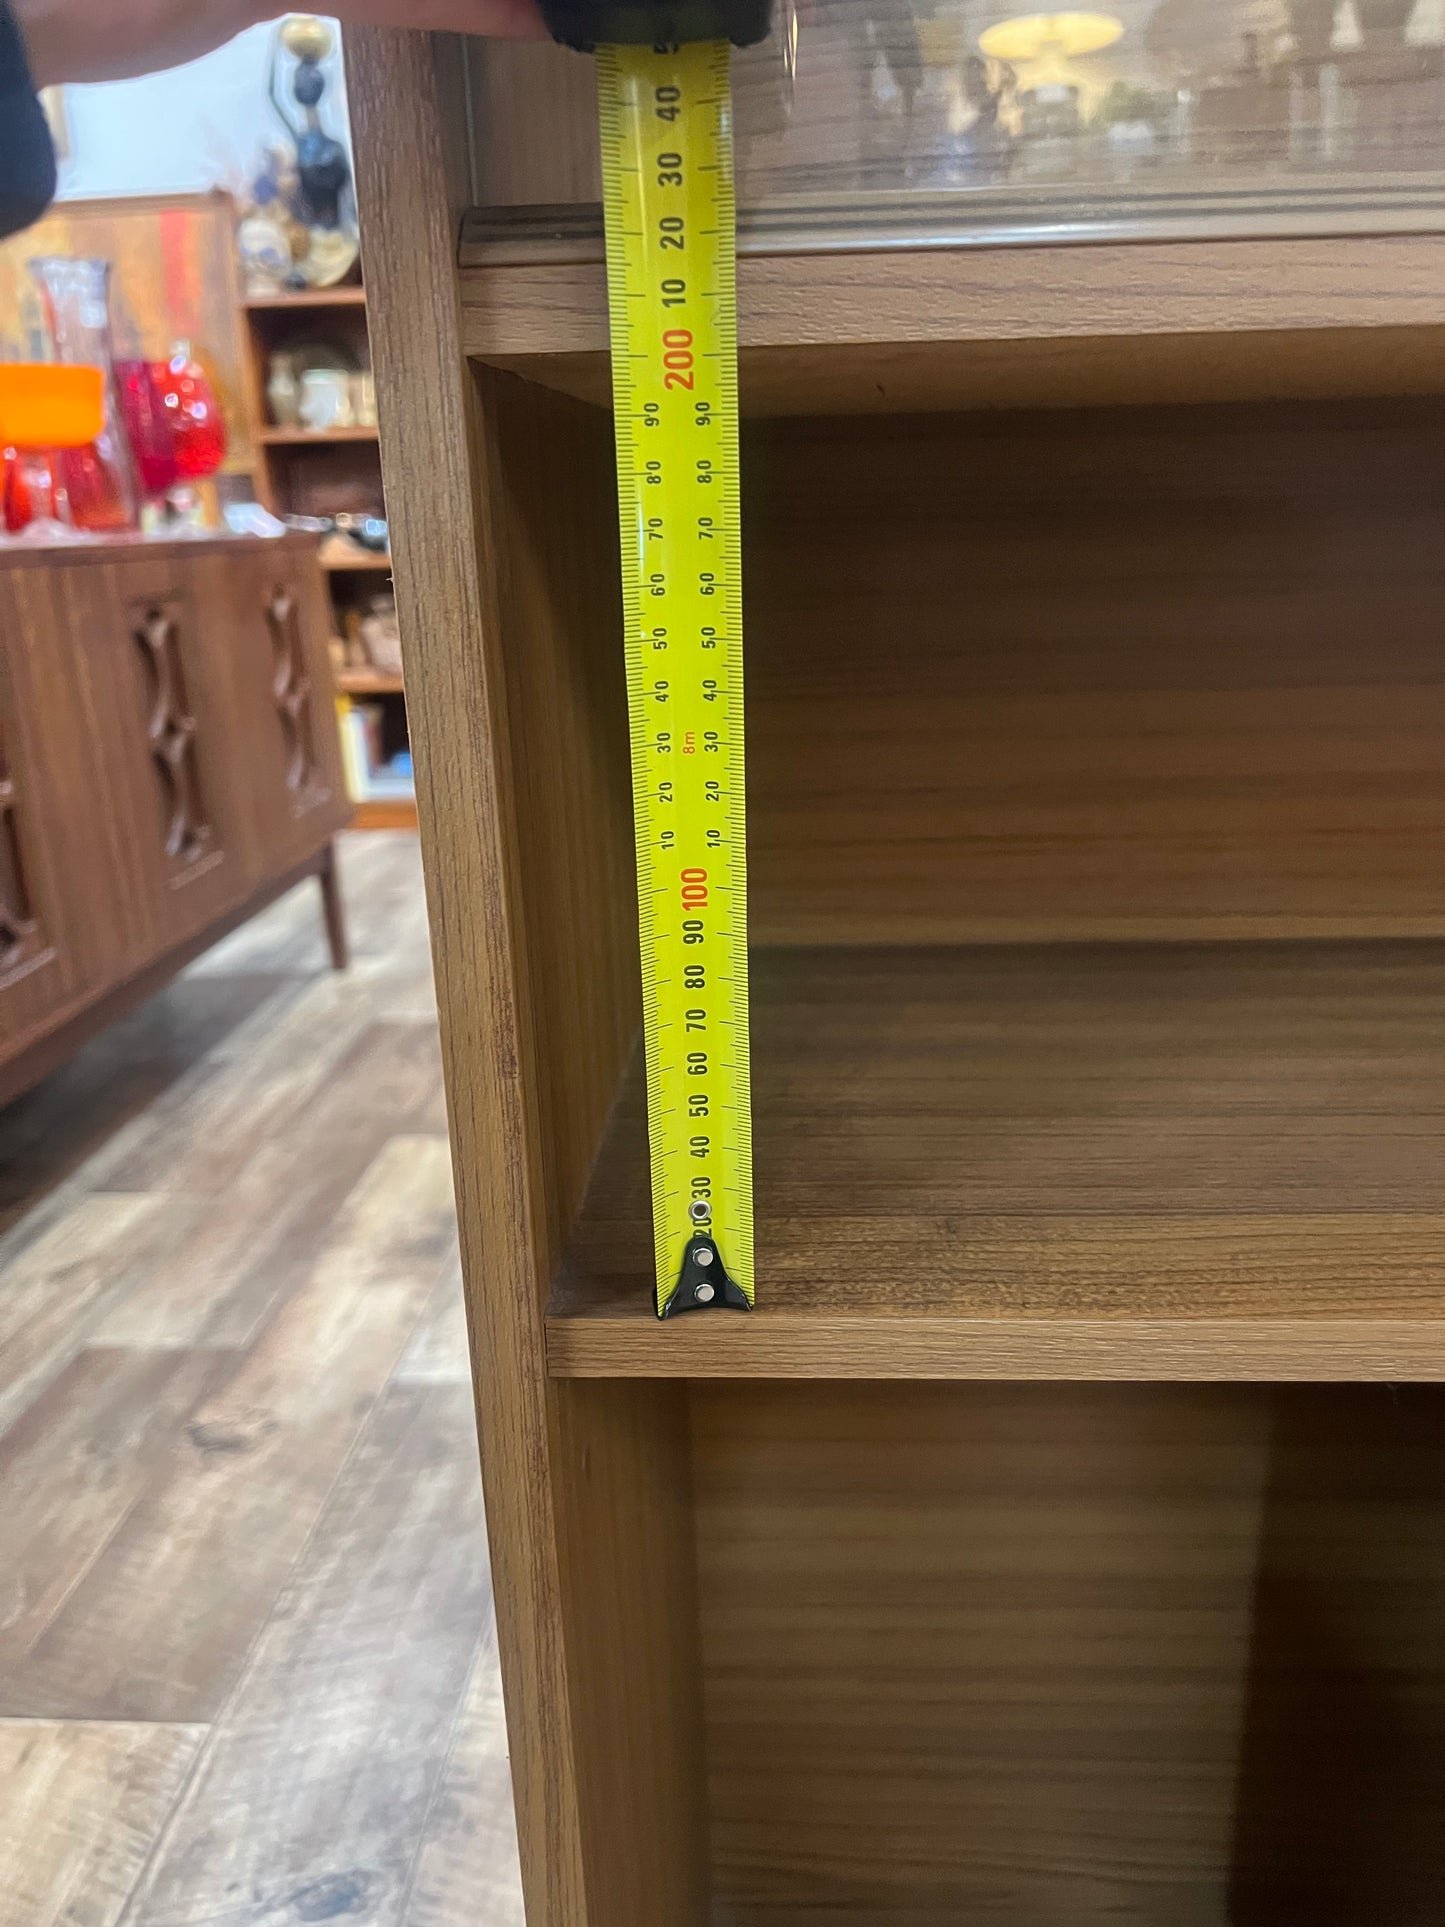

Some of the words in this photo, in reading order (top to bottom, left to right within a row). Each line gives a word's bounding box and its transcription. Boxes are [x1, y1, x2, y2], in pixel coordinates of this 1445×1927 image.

[655, 86, 680, 122] 40
[657, 153, 682, 187] 30
[659, 217, 684, 250] 20
[661, 279, 686, 308] 10
[663, 330, 693, 390] 200
[644, 403, 659, 426] 90
[695, 402, 710, 426] 90
[646, 461, 661, 484] 80
[697, 460, 712, 483] 80
[648, 518, 663, 540] 70
[698, 518, 713, 539] 70
[651, 574, 665, 596] 60
[700, 573, 714, 595] 60
[653, 628, 667, 650] 50
[701, 627, 716, 648] 50
[655, 681, 669, 702] 40
[703, 680, 717, 701] 40
[657, 733, 671, 753] 30
[683, 732, 695, 754] 8m
[704, 732, 718, 752] 30
[659, 782, 672, 802] 20
[705, 781, 719, 801] 20
[661, 831, 674, 849] 10
[707, 830, 720, 848] 10
[681, 868, 708, 911] 100
[682, 920, 704, 944] 90
[684, 965, 705, 988] 80
[685, 1009, 706, 1032] 70
[687, 1052, 707, 1075] 60
[688, 1095, 708, 1117] 50
[690, 1136, 710, 1158] 40
[691, 1177, 710, 1198] 30
